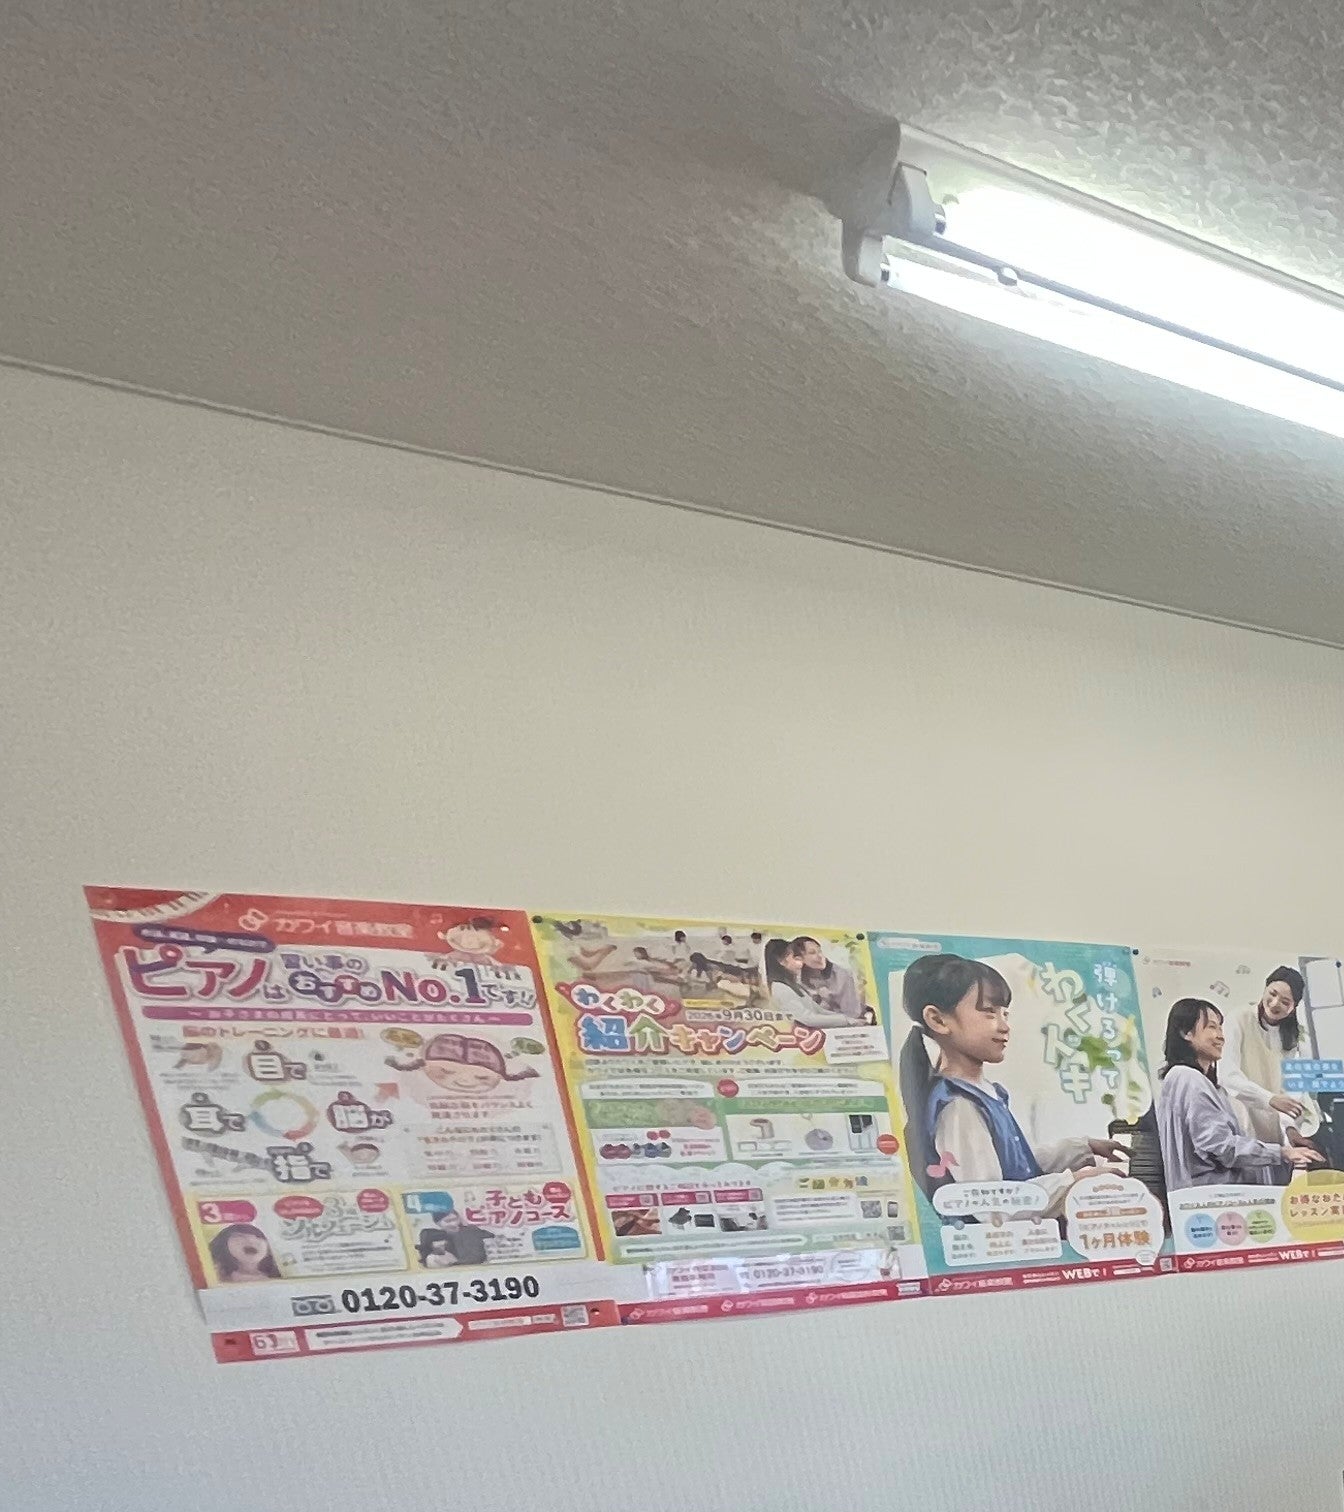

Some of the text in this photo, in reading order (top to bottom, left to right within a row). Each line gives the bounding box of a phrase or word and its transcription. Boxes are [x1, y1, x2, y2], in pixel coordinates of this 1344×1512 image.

[573, 986, 661, 1013] わくわく
[579, 1014, 824, 1054] 紹介キャンペーン
[250, 1052, 306, 1080] 目で
[184, 1105, 245, 1132] 耳で
[272, 1152, 332, 1181] 指で
[485, 1188, 542, 1208] 子ども
[464, 1205, 571, 1225] ピアノコース
[341, 1275, 540, 1313] 0120-37-3190
